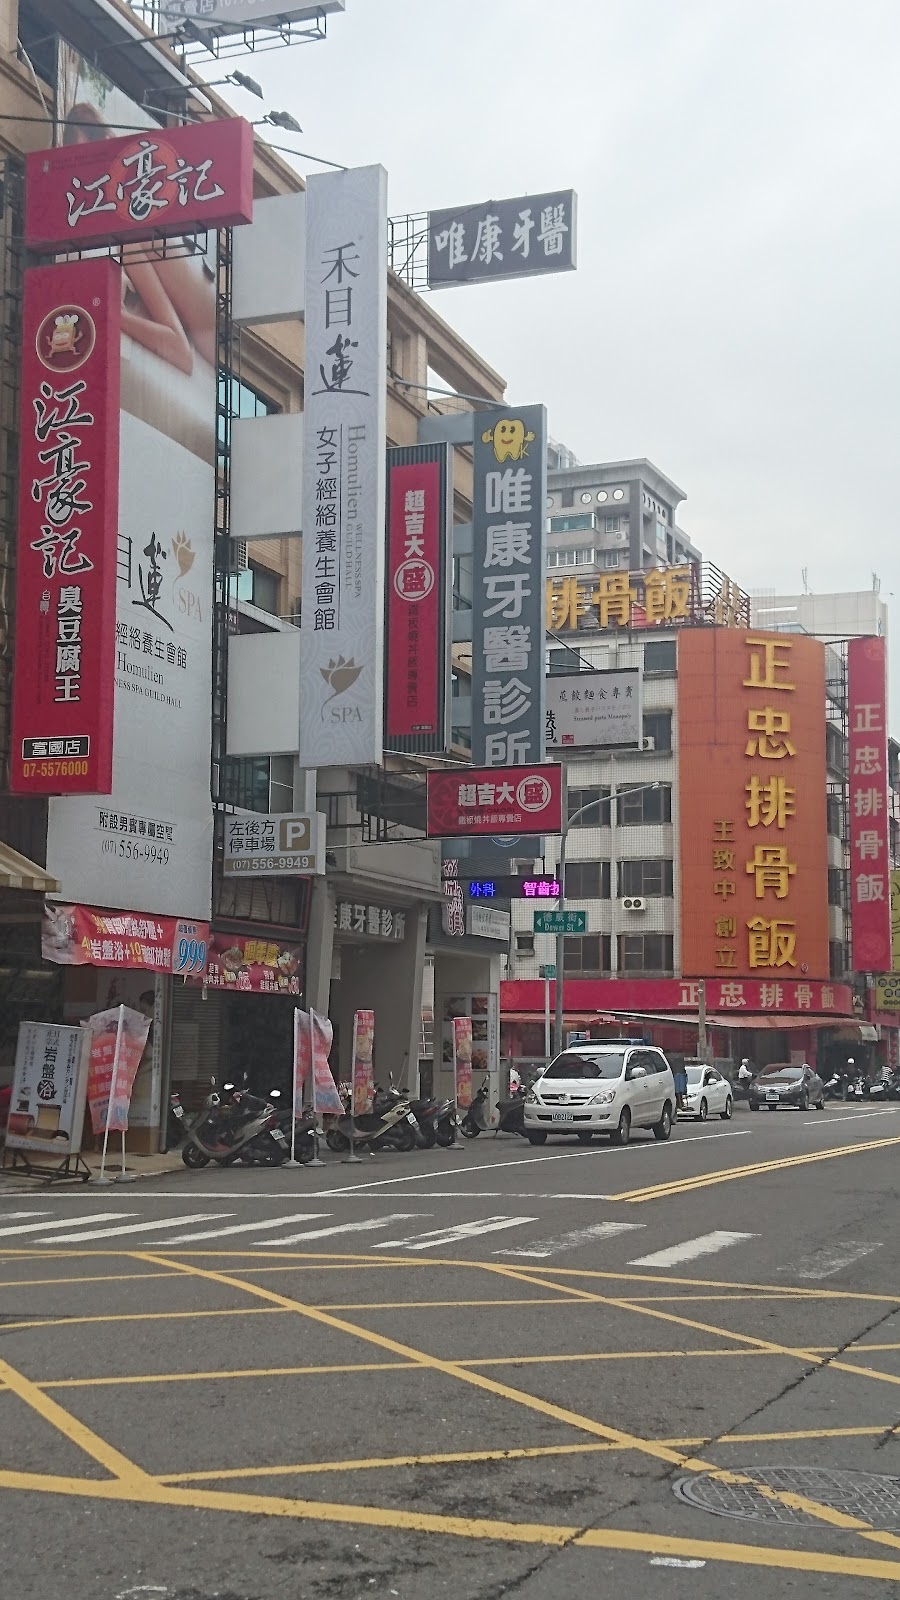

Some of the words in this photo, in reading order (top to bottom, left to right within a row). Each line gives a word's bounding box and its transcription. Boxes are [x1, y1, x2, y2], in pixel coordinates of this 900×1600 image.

[66, 141, 225, 227] 江豪記
[434, 203, 568, 269] 唯康牙醫
[311, 241, 371, 397] 禾目蓮
[31, 380, 94, 580] 江豪記
[346, 424, 366, 520] Homulien
[313, 425, 338, 631] 女子經絡養生會館
[178, 587, 203, 623] SPA
[482, 467, 533, 765] 唯康牙醫診所
[54, 586, 83, 702] 臭豆腐王
[117, 651, 165, 685] Homulien
[331, 706, 364, 723] SPA
[31, 739, 82, 756] 富國店
[23, 761, 89, 778] 07-5576000
[742, 635, 797, 968] 正忠排骨飯
[853, 703, 885, 903] 正忠排骨飯
[229, 819, 276, 836] 左後方
[229, 837, 276, 854] 停車場
[285, 821, 306, 849] P
[118, 840, 170, 866] 556-9949
[232, 858, 250, 871] (07)
[251, 856, 309, 870] 556-9949
[712, 820, 736, 900] 王致中
[470, 882, 496, 897] 外科
[334, 902, 406, 939] 康牙醫診所
[177, 938, 207, 974] 999
[715, 915, 737, 968] 創立
[678, 982, 835, 1009] 正忠排骨飯
